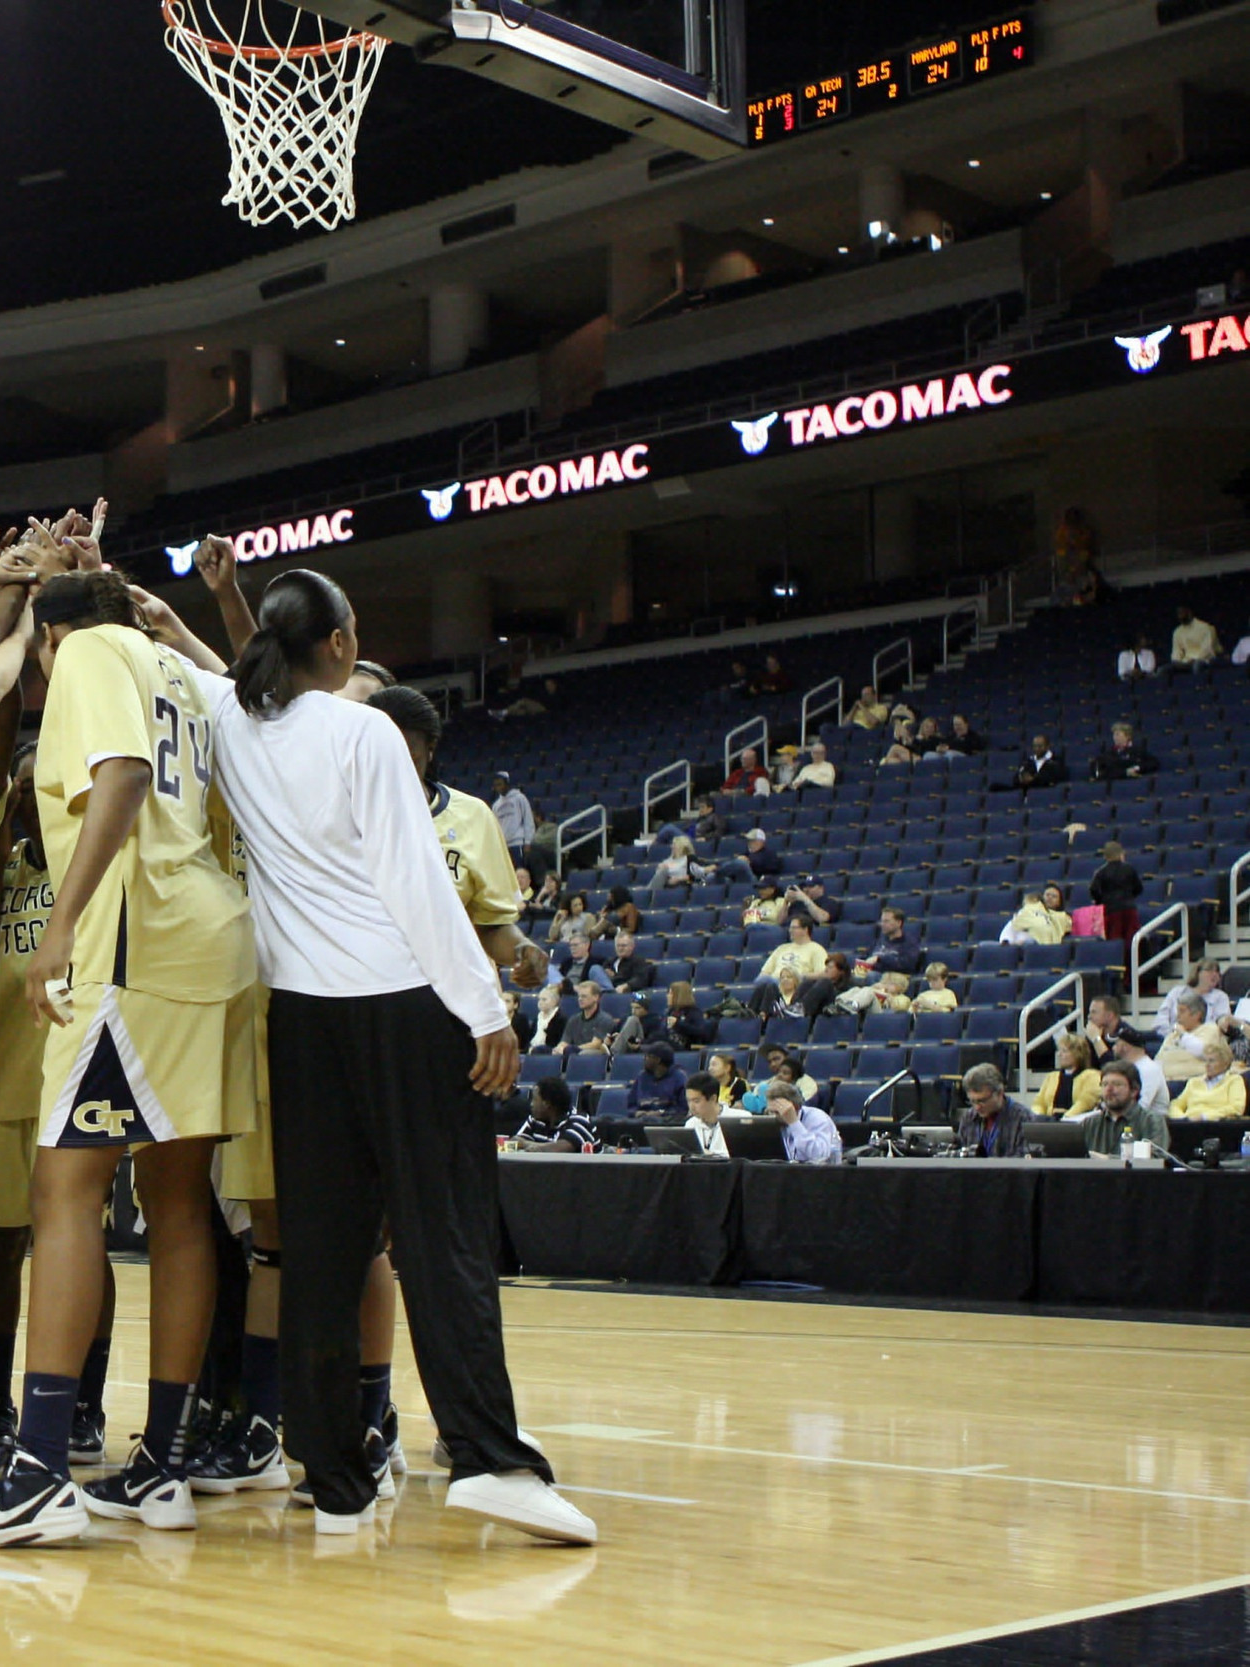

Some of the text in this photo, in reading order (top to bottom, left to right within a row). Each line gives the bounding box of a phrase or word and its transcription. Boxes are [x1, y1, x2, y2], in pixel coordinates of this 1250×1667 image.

[971, 20, 1022, 47] PLR F PTS
[911, 40, 957, 65] MARYLAND
[975, 45, 1024, 73] 10 4
[820, 77, 842, 93] TECH
[856, 61, 891, 87] 38.5
[927, 61, 948, 83] 24
[889, 83, 897, 98] 2
[748, 93, 793, 116] PLR F PTS
[784, 104, 794, 117] 2
[817, 96, 837, 118] 24
[755, 117, 794, 140] 5 3
[1180, 315, 1250, 361] TA
[783, 364, 1013, 446] TACO MAC
[464, 443, 649, 512] TACO MAC
[223, 508, 354, 563] CO MAC
[154, 695, 212, 810] 24
[2, 919, 49, 954] TEC
[72, 1100, 135, 1137] GT
